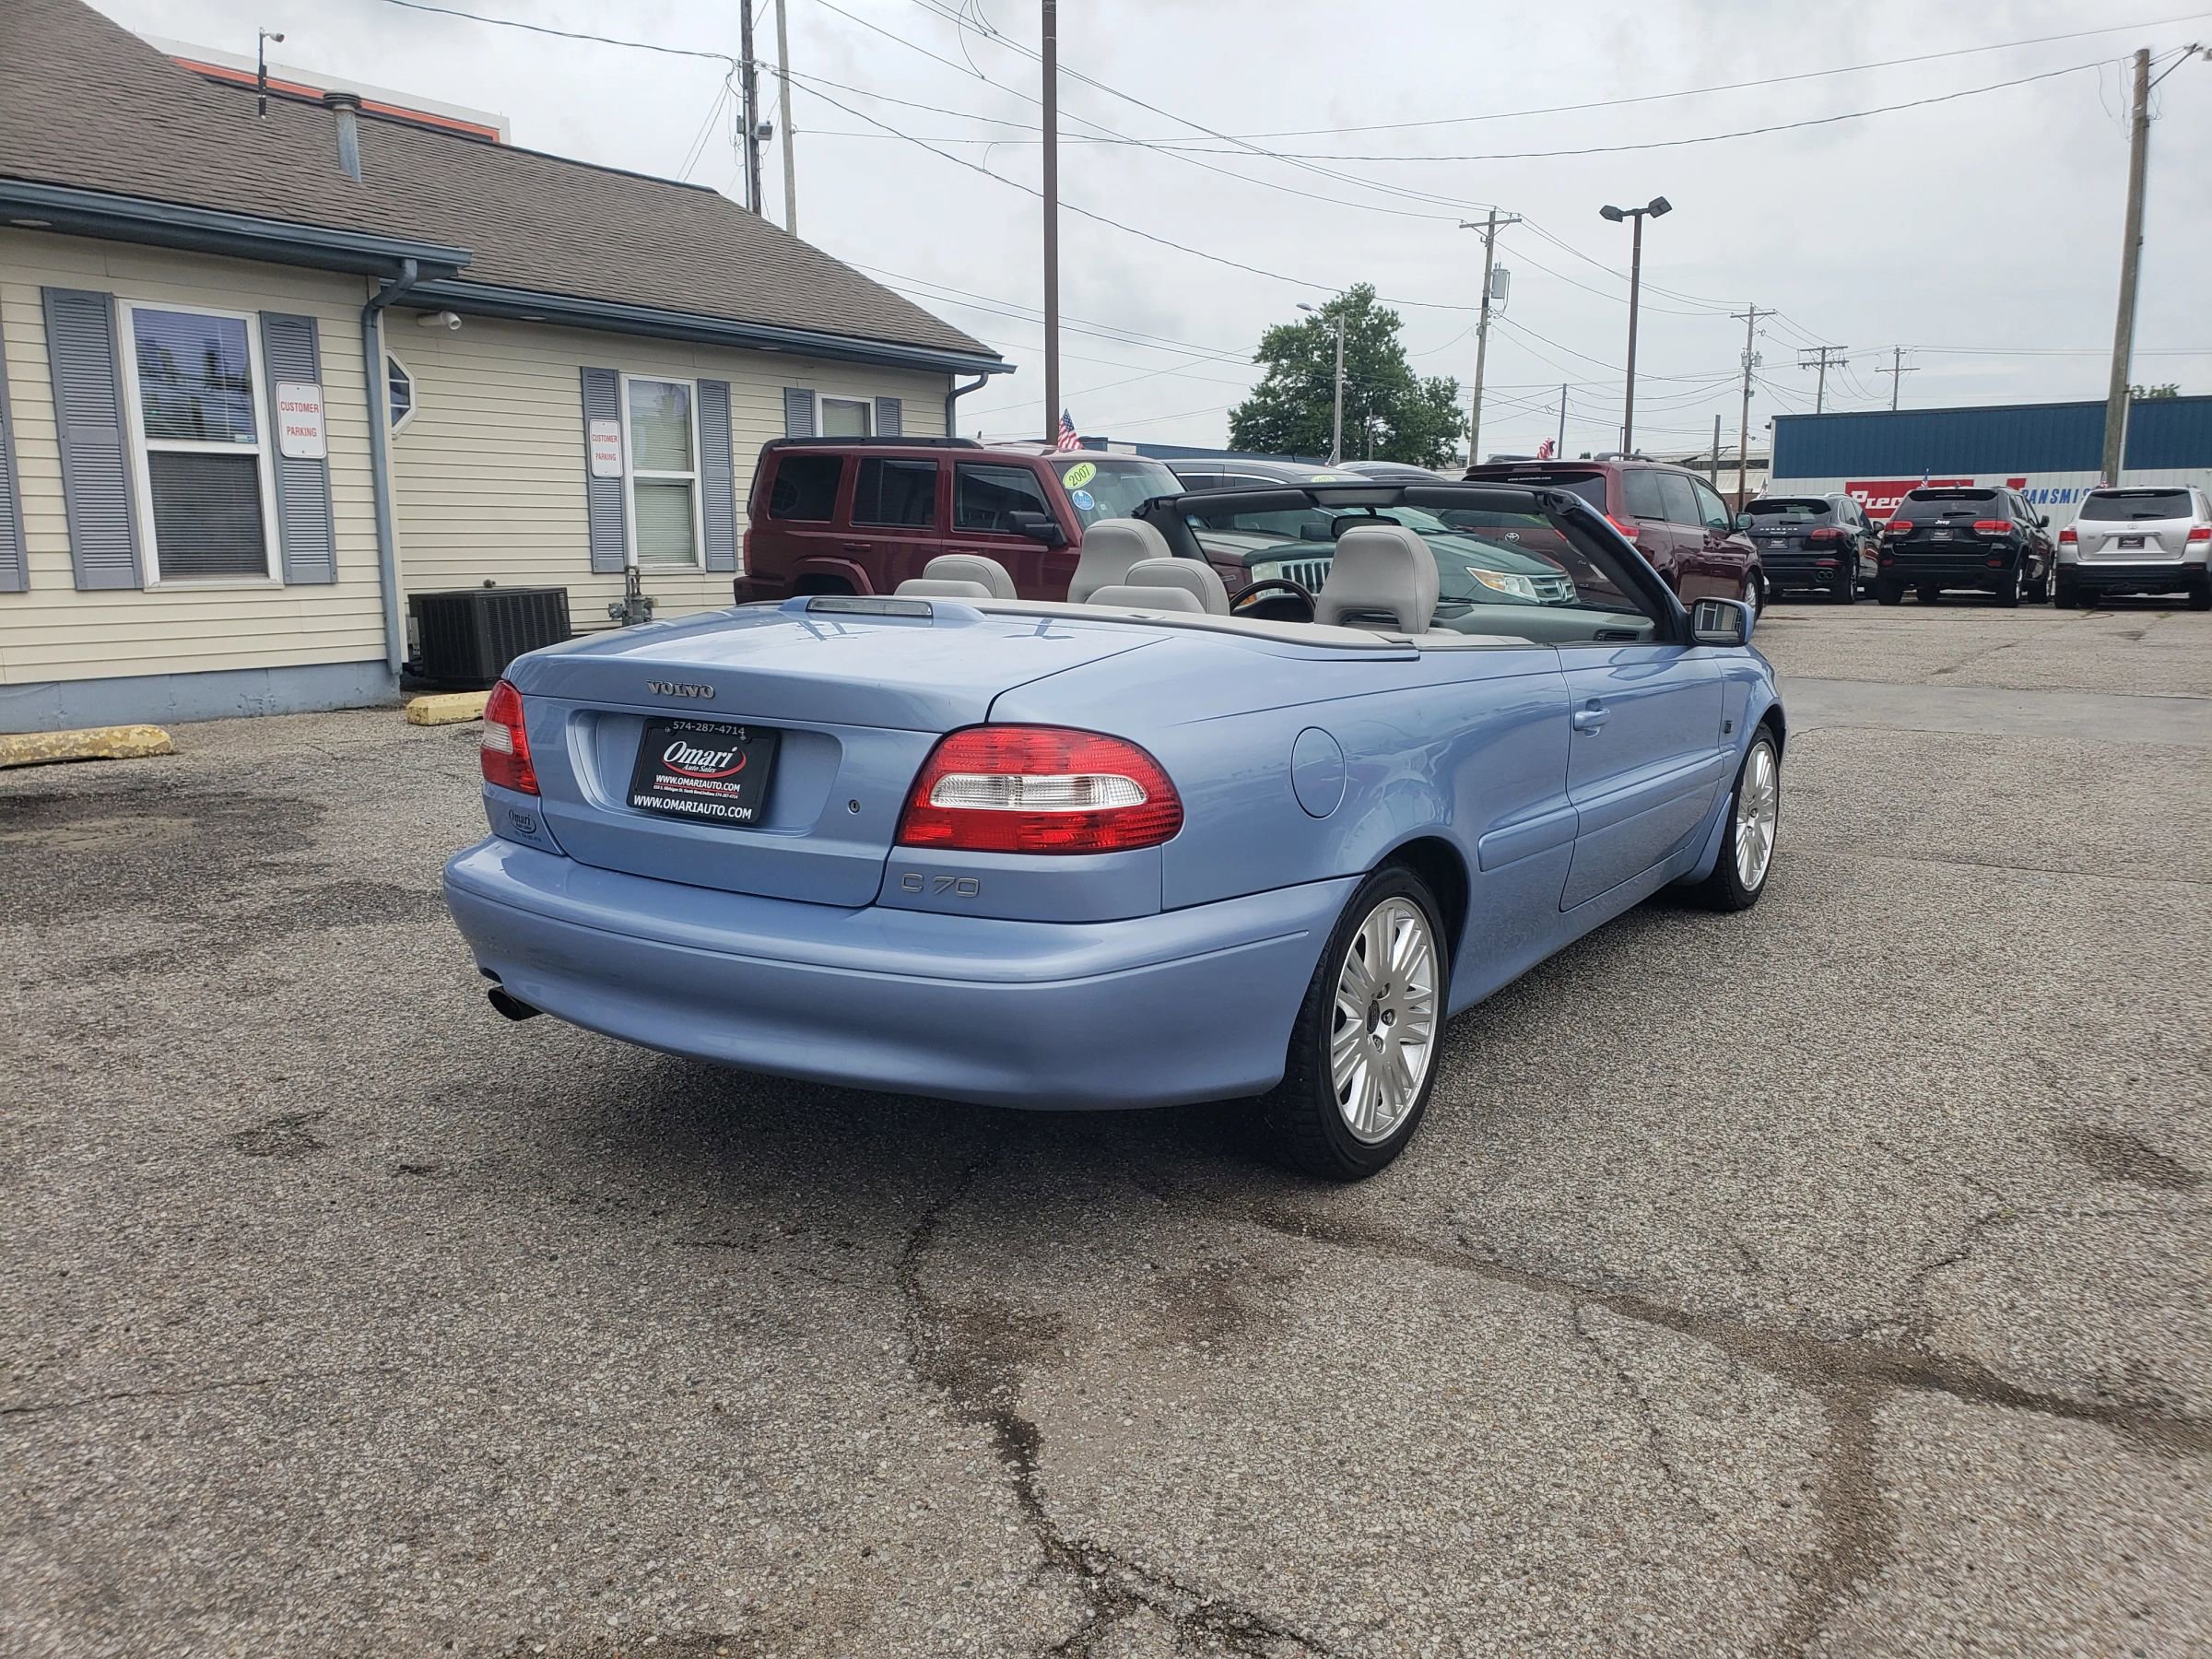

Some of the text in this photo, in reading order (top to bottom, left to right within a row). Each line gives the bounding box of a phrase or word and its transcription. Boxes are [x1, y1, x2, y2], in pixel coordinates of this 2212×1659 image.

[280, 401, 319, 413] CUSTOMER
[287, 426, 317, 437] PARKING
[592, 434, 618, 442] CUSTOMER
[595, 453, 617, 461] PARKING
[1069, 465, 1090, 487] 2007
[646, 680, 715, 699] VOLVO
[673, 721, 746, 736] 574-287-4714
[663, 740, 738, 768] Omari
[655, 774, 741, 792] WWW.OMARIAUTO.COM
[633, 794, 753, 819] WWW.OMARIAUTO.COM
[508, 809, 531, 826] Omari
